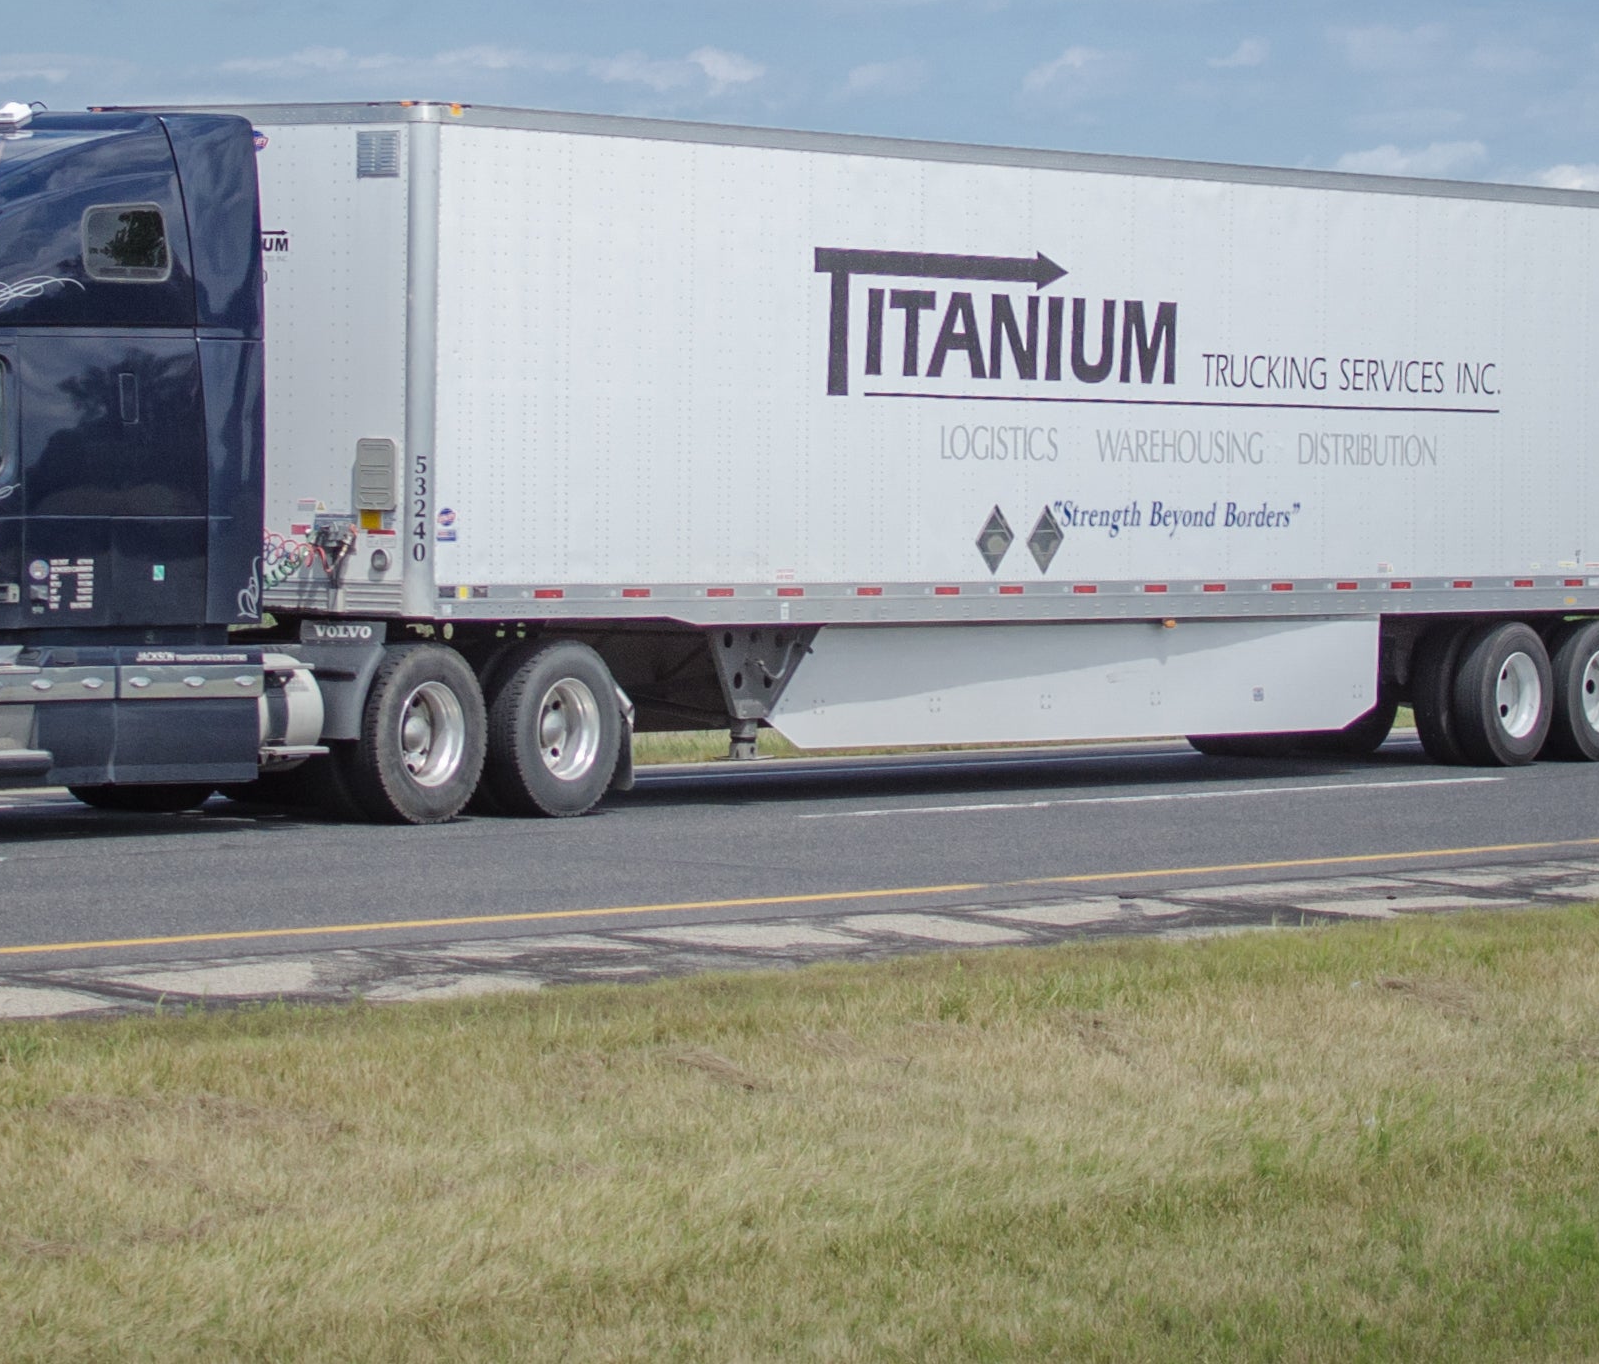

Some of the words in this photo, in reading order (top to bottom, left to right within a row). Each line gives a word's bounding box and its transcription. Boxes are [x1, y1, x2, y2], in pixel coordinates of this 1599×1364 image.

[814, 247, 1178, 396] TITANIUM
[1202, 353, 1327, 391] TRUCKING
[1339, 358, 1445, 394] SERVICES
[1456, 362, 1501, 396] INC.
[939, 424, 1059, 462] LOGISTICS
[1096, 429, 1264, 465] WAREHOUSING
[1298, 432, 1437, 467] DISTRIBUTION
[412, 455, 428, 562] 53240
[1149, 500, 1218, 539] Beyond
[313, 624, 373, 639] VOLVO
